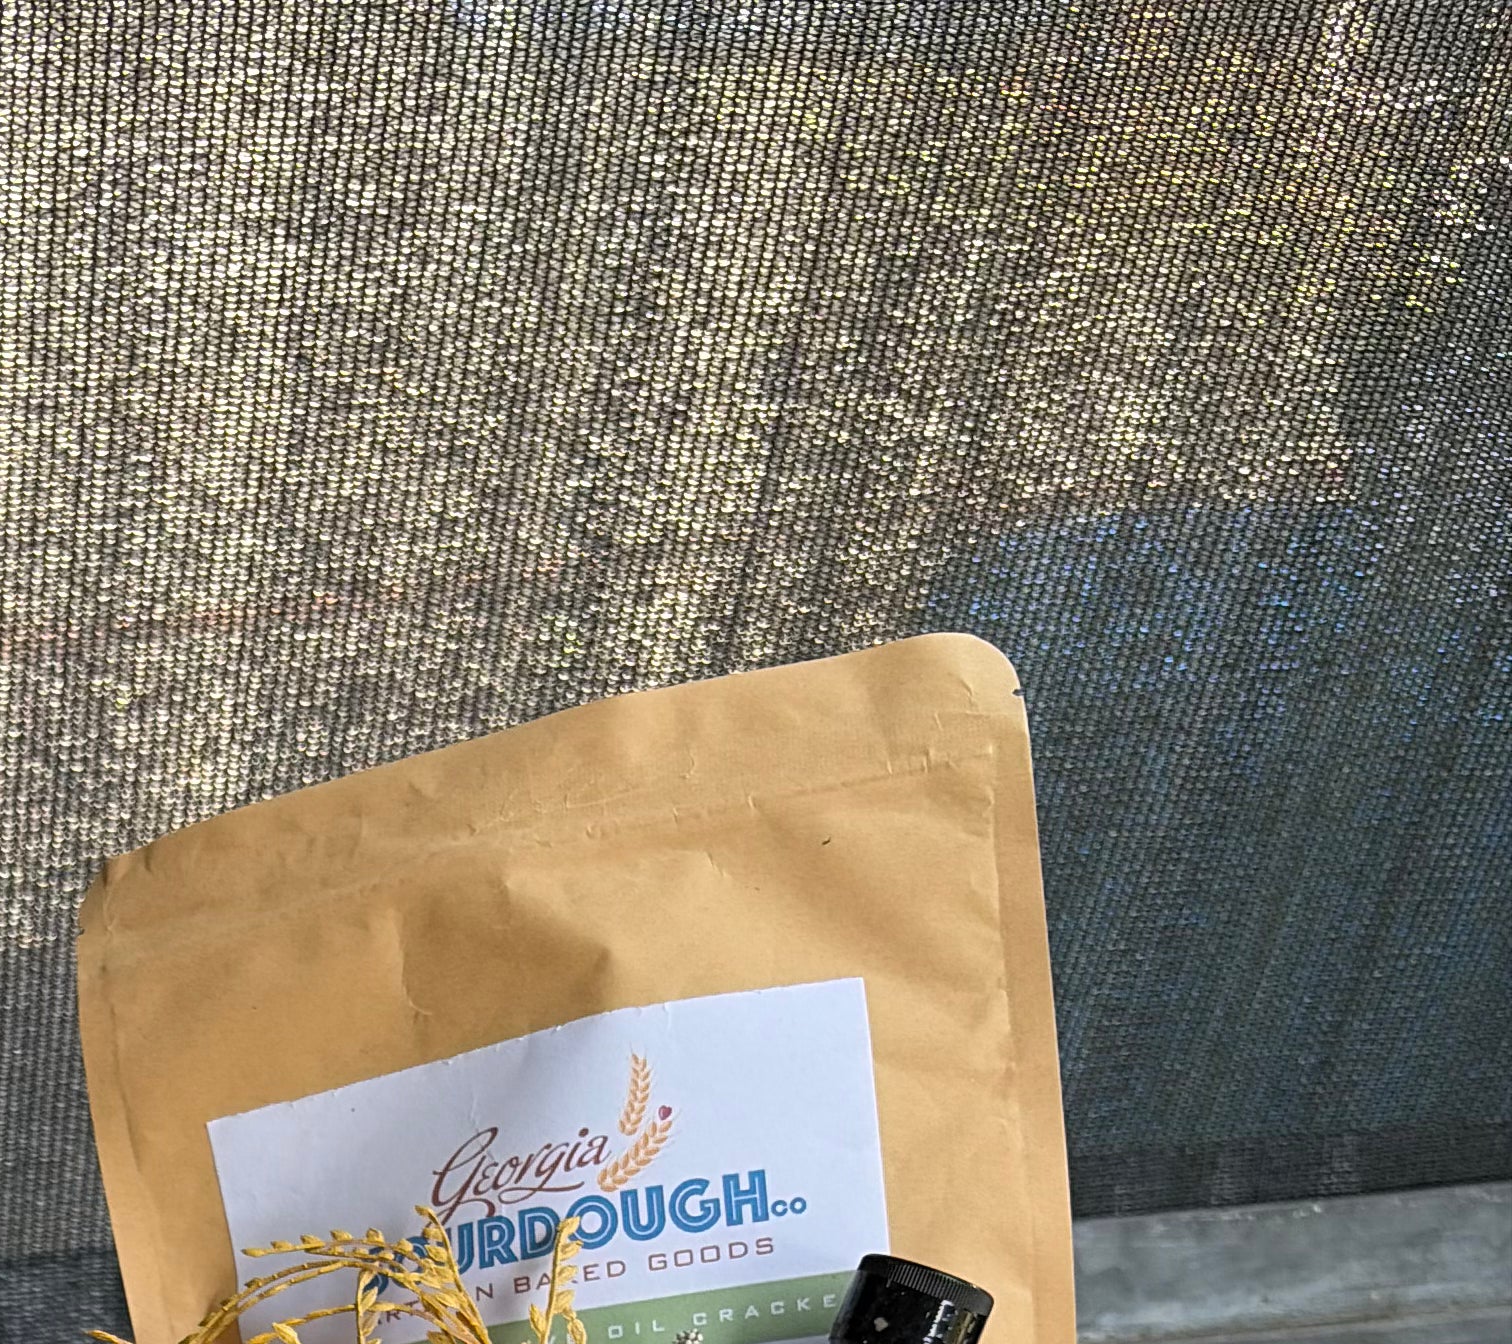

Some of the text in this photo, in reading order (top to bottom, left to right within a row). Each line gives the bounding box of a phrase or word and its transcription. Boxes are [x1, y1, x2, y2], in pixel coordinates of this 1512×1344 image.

[426, 1127, 610, 1228] Georgia
[513, 1237, 774, 1295] BAED GOODS
[608, 1320, 665, 1340] OIL
[692, 1294, 837, 1326] CRACKE
